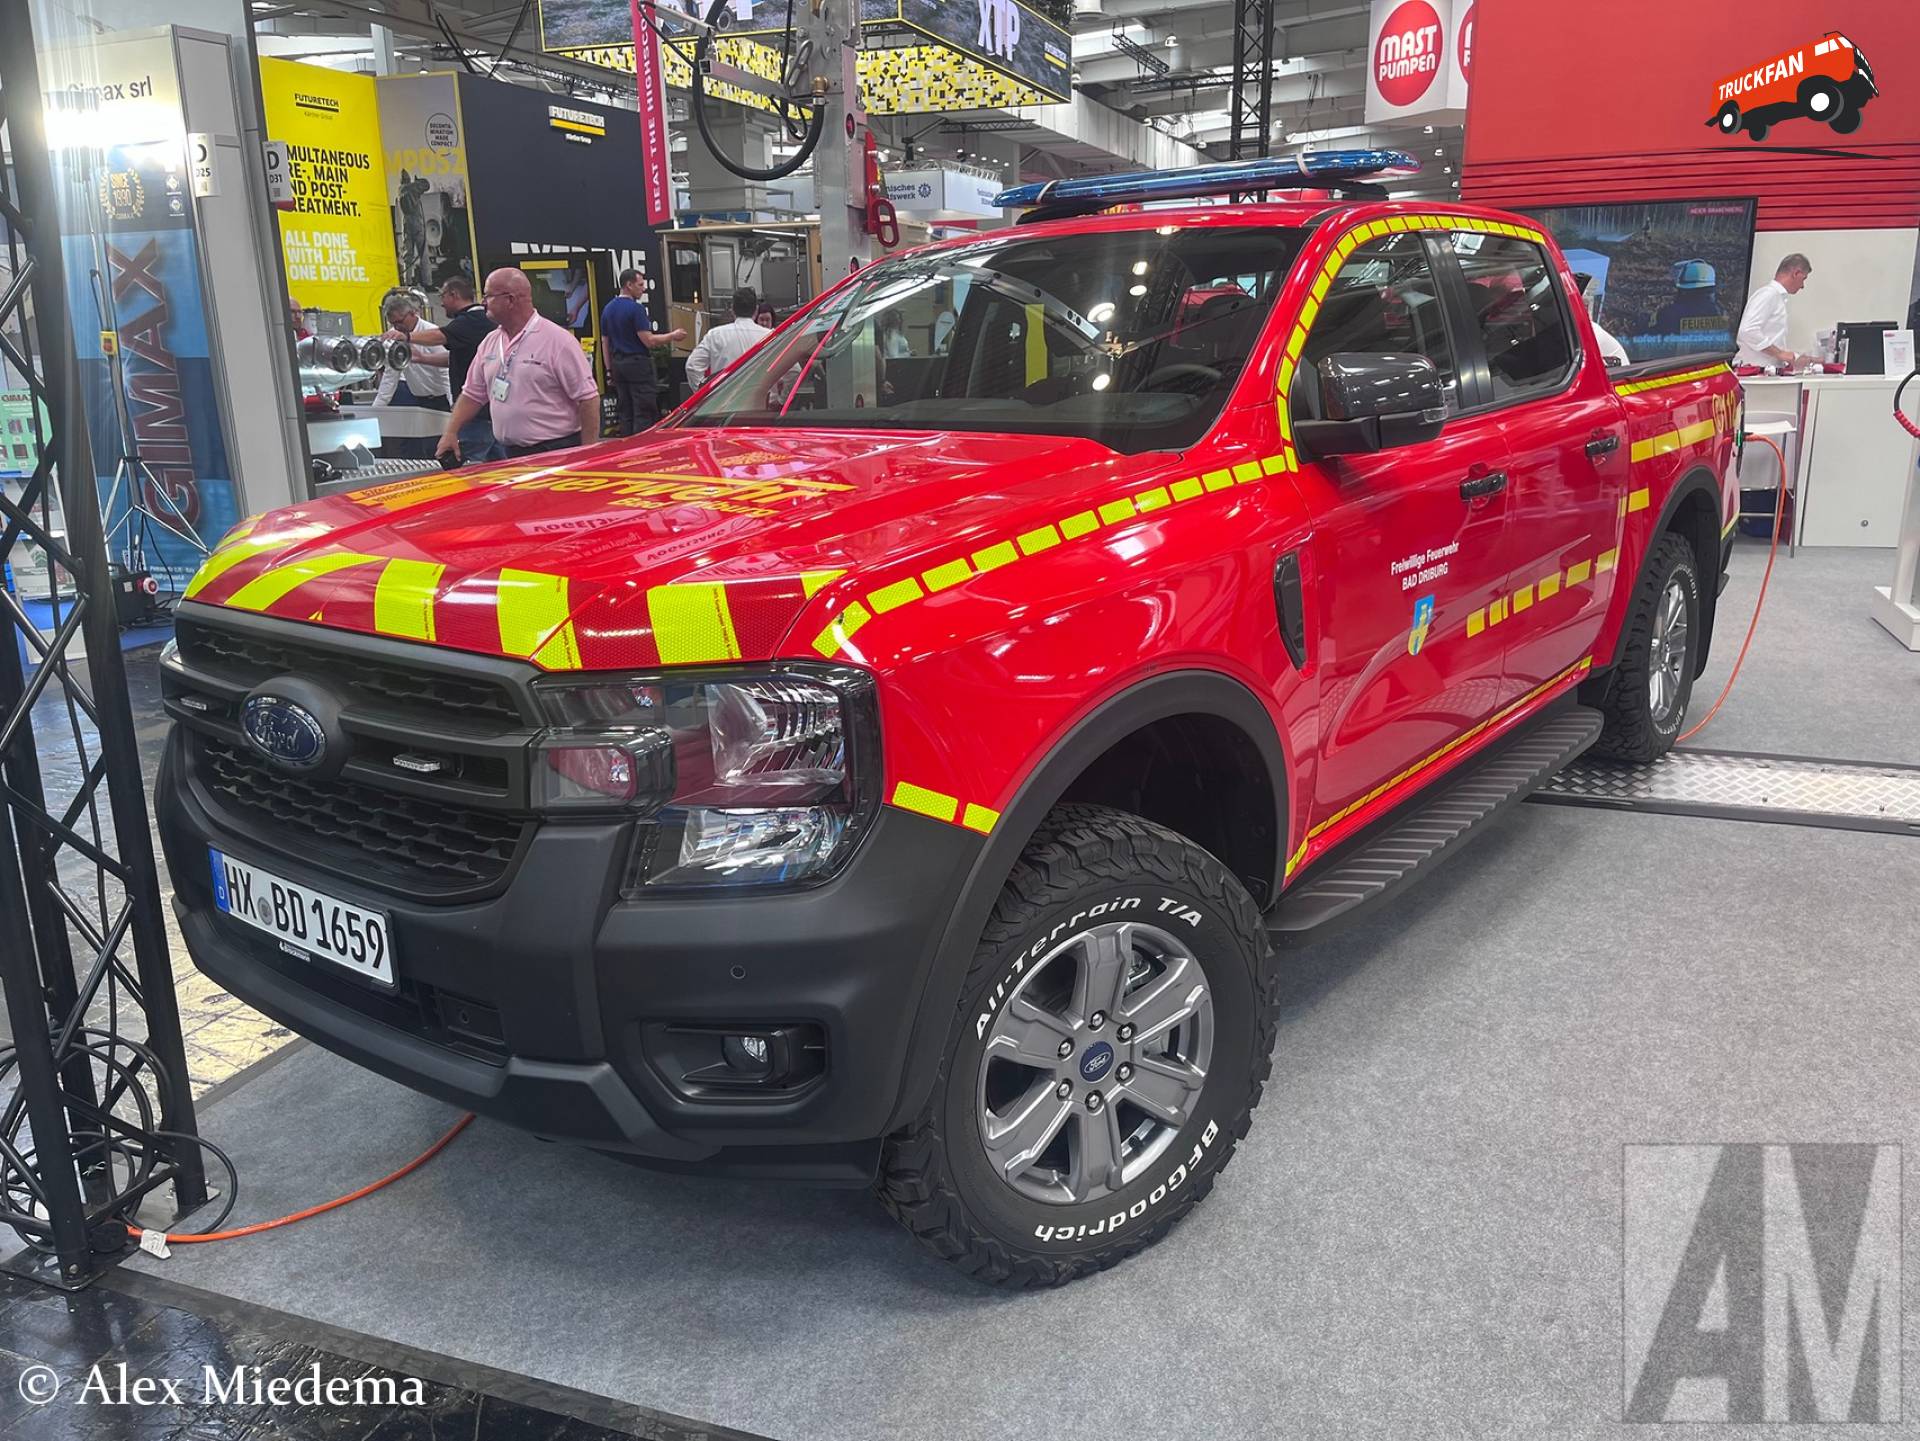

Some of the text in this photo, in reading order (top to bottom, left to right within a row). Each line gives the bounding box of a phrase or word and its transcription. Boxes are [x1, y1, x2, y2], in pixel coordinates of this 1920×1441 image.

[1380, 25, 1437, 63] MAST
[1379, 53, 1436, 81] PUMPEN
[129, 75, 153, 98] srl
[294, 93, 339, 107] FUTURETECH
[648, 117, 657, 158] THE
[266, 150, 280, 171] D
[286, 144, 370, 170] MULTANEOUS
[269, 174, 283, 184] D31
[313, 164, 349, 183] MAIN
[289, 179, 348, 199] ND POST-
[652, 162, 662, 212] BEAT
[293, 196, 361, 218] REATMENT.
[286, 229, 349, 249] ALL DONE
[288, 247, 357, 266] WITH JUST
[290, 264, 370, 283] ONE DEVICE.
[105, 236, 202, 533] GIMAX
[1391, 540, 1460, 576] Freiwillige Feuerwehr
[1402, 562, 1448, 591] BAD DRIBURG
[224, 862, 383, 969] HX BD 1659
[976, 896, 1202, 1041] All-Terrain T/A
[1034, 1119, 1219, 1243] BFGoodrich
